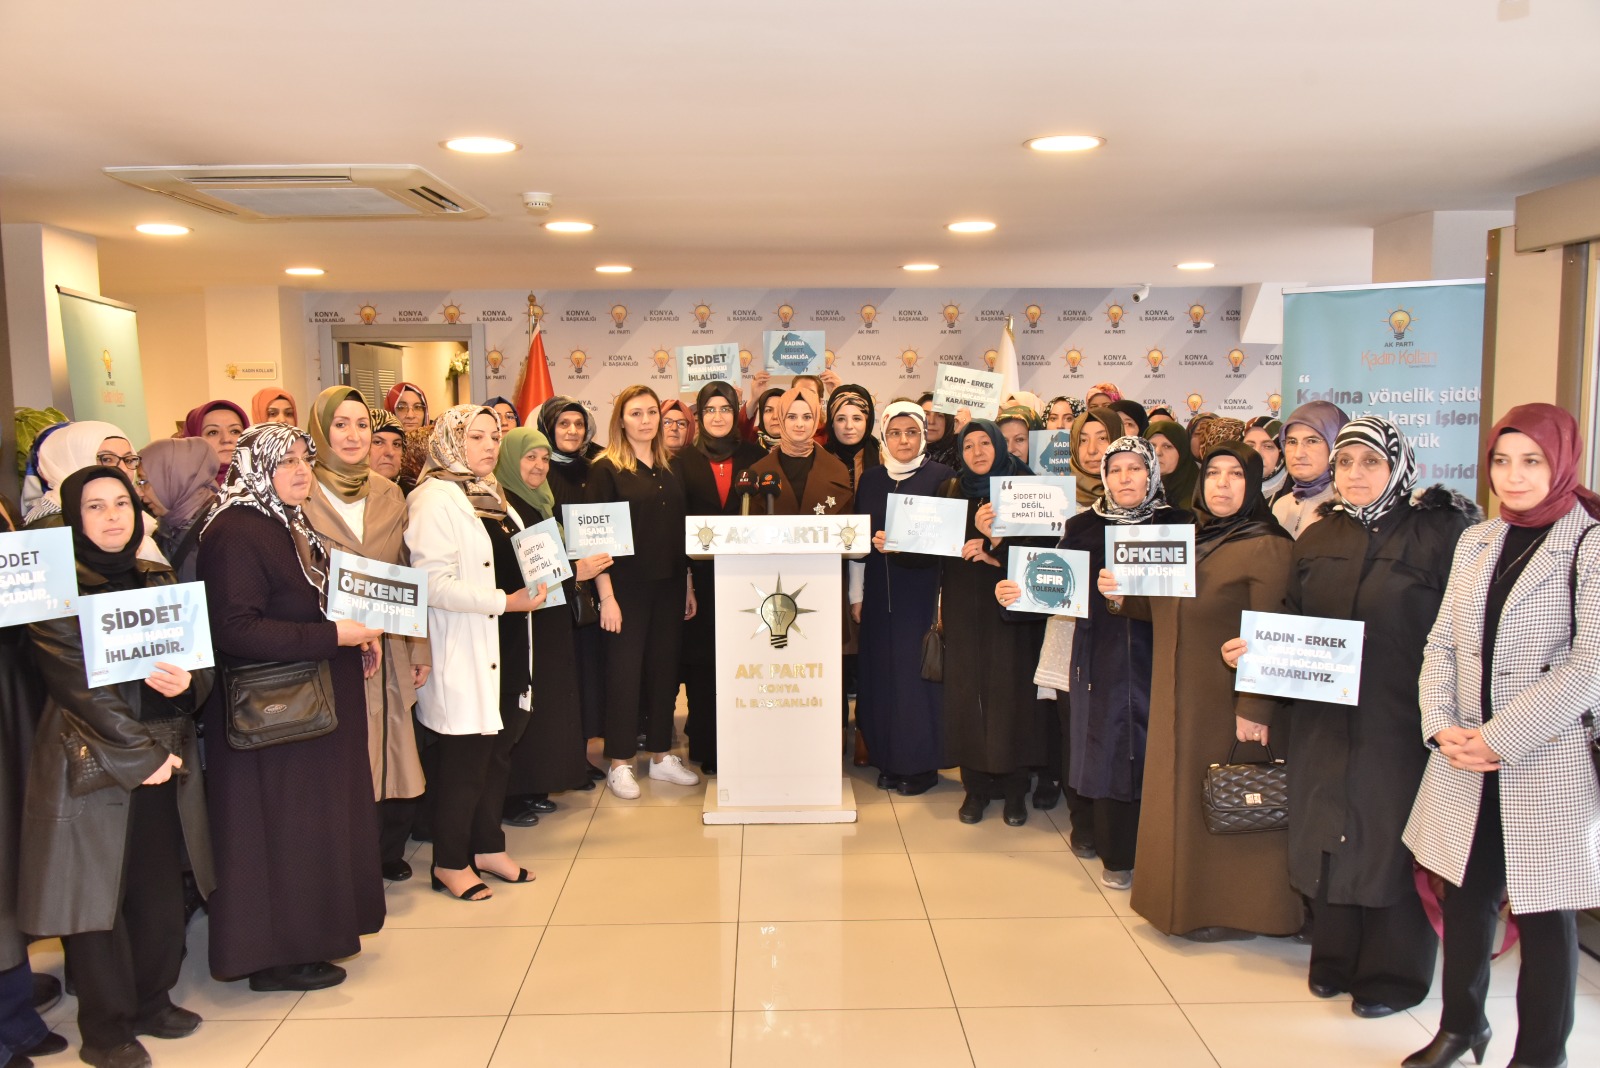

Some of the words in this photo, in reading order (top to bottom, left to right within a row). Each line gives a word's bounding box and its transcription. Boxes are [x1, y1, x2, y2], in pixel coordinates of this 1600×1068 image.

[687, 354, 726, 367] ŞİDDET
[689, 371, 727, 381] İHLALİDİR.
[945, 375, 966, 384] KADIN
[971, 380, 994, 389] ERKEK
[1296, 388, 1363, 404] Kadına
[1368, 387, 1434, 406] yönelik
[1389, 411, 1431, 427] karşı
[1021, 501, 1045, 509] DEĞİL,
[578, 515, 610, 526] ŞİDDET
[725, 527, 759, 544] AK
[1116, 544, 1184, 563] ÖFKENE
[341, 572, 414, 603] ÖFKENE
[1036, 574, 1063, 585] SIFIR
[373, 601, 415, 617] DÜŞME!
[101, 603, 182, 634] ŞİDDET
[1256, 630, 1295, 643] KADIN
[1305, 635, 1347, 649] ERKEK
[105, 639, 184, 663] İHLALİDİR.
[735, 664, 763, 679] AK
[1261, 666, 1335, 683] KARARLIYIZ.
[759, 684, 799, 693] KONYA
[736, 697, 746, 708] İL
